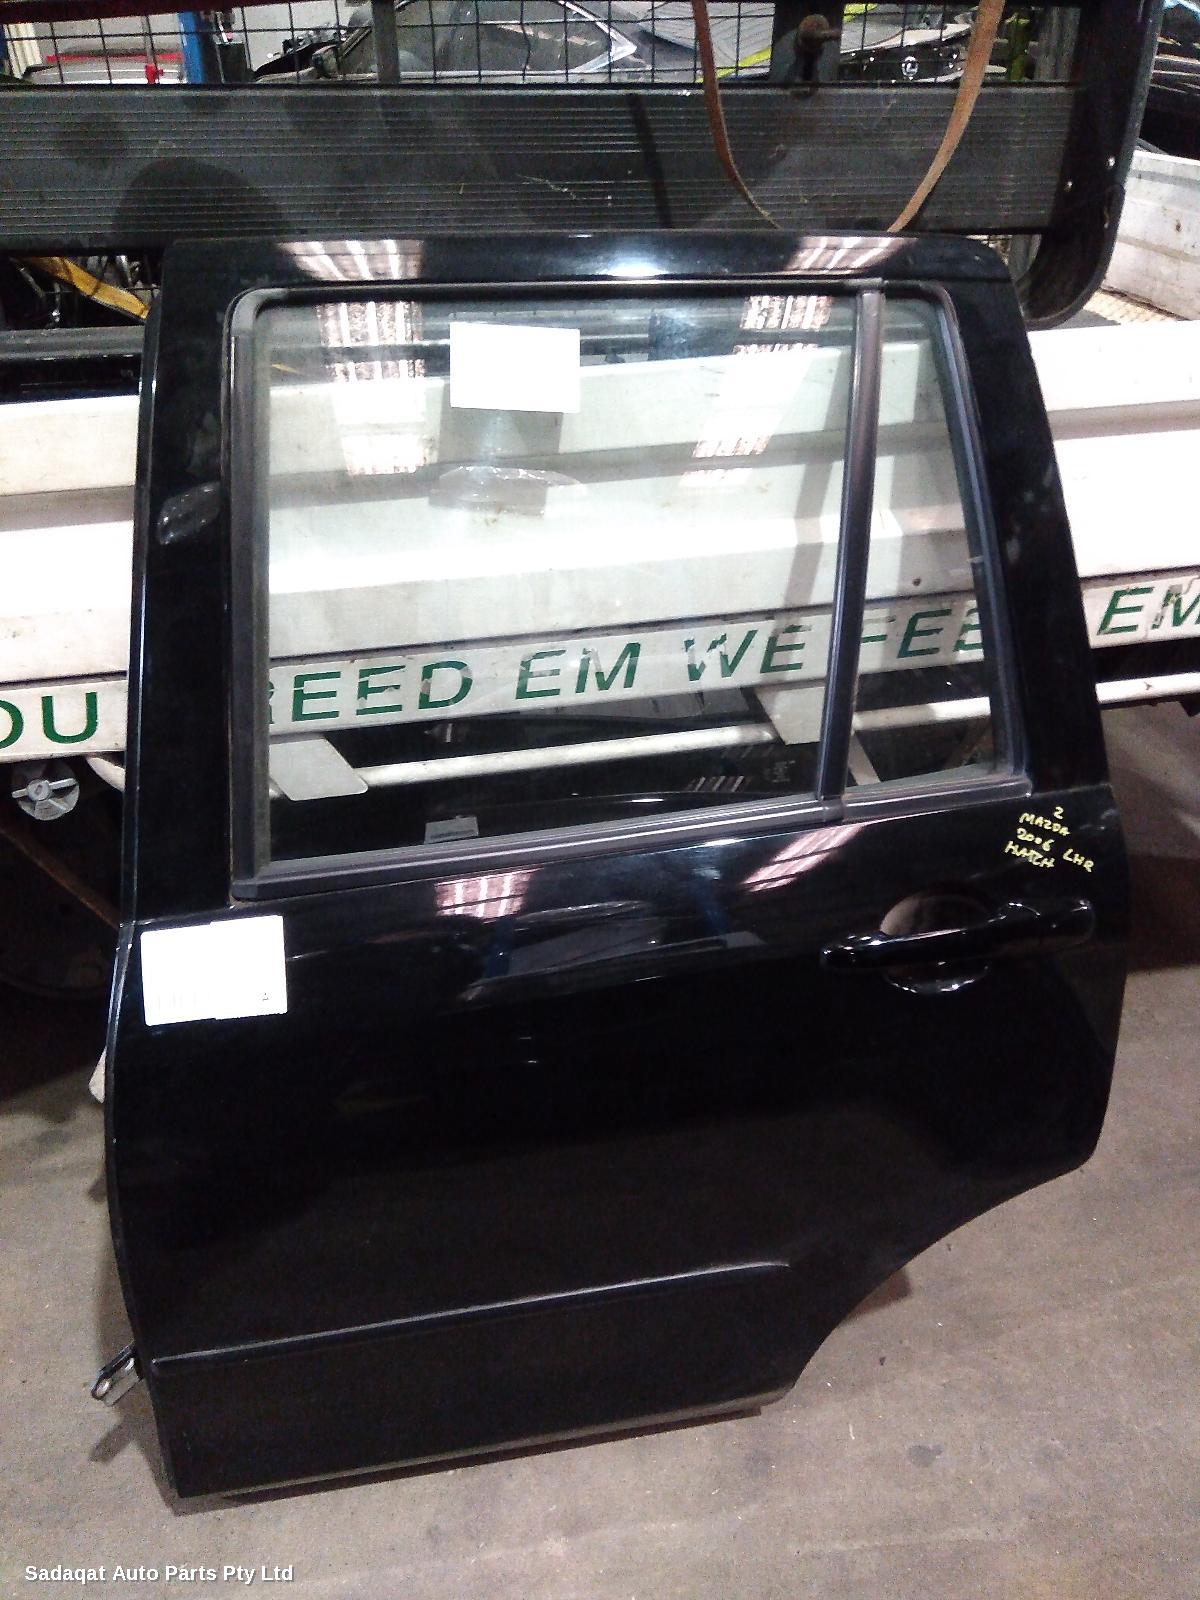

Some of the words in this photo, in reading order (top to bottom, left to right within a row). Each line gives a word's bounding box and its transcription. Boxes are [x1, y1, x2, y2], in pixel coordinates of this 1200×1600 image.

[269, 660, 474, 725] EED
[515, 642, 641, 700] EM
[684, 625, 813, 682] WE
[1019, 812, 1071, 836] MAZDA
[1053, 806, 1064, 820] 2
[1004, 840, 1056, 868] HATCH
[1017, 827, 1055, 852] 2006
[1063, 848, 1095, 873] LHR
